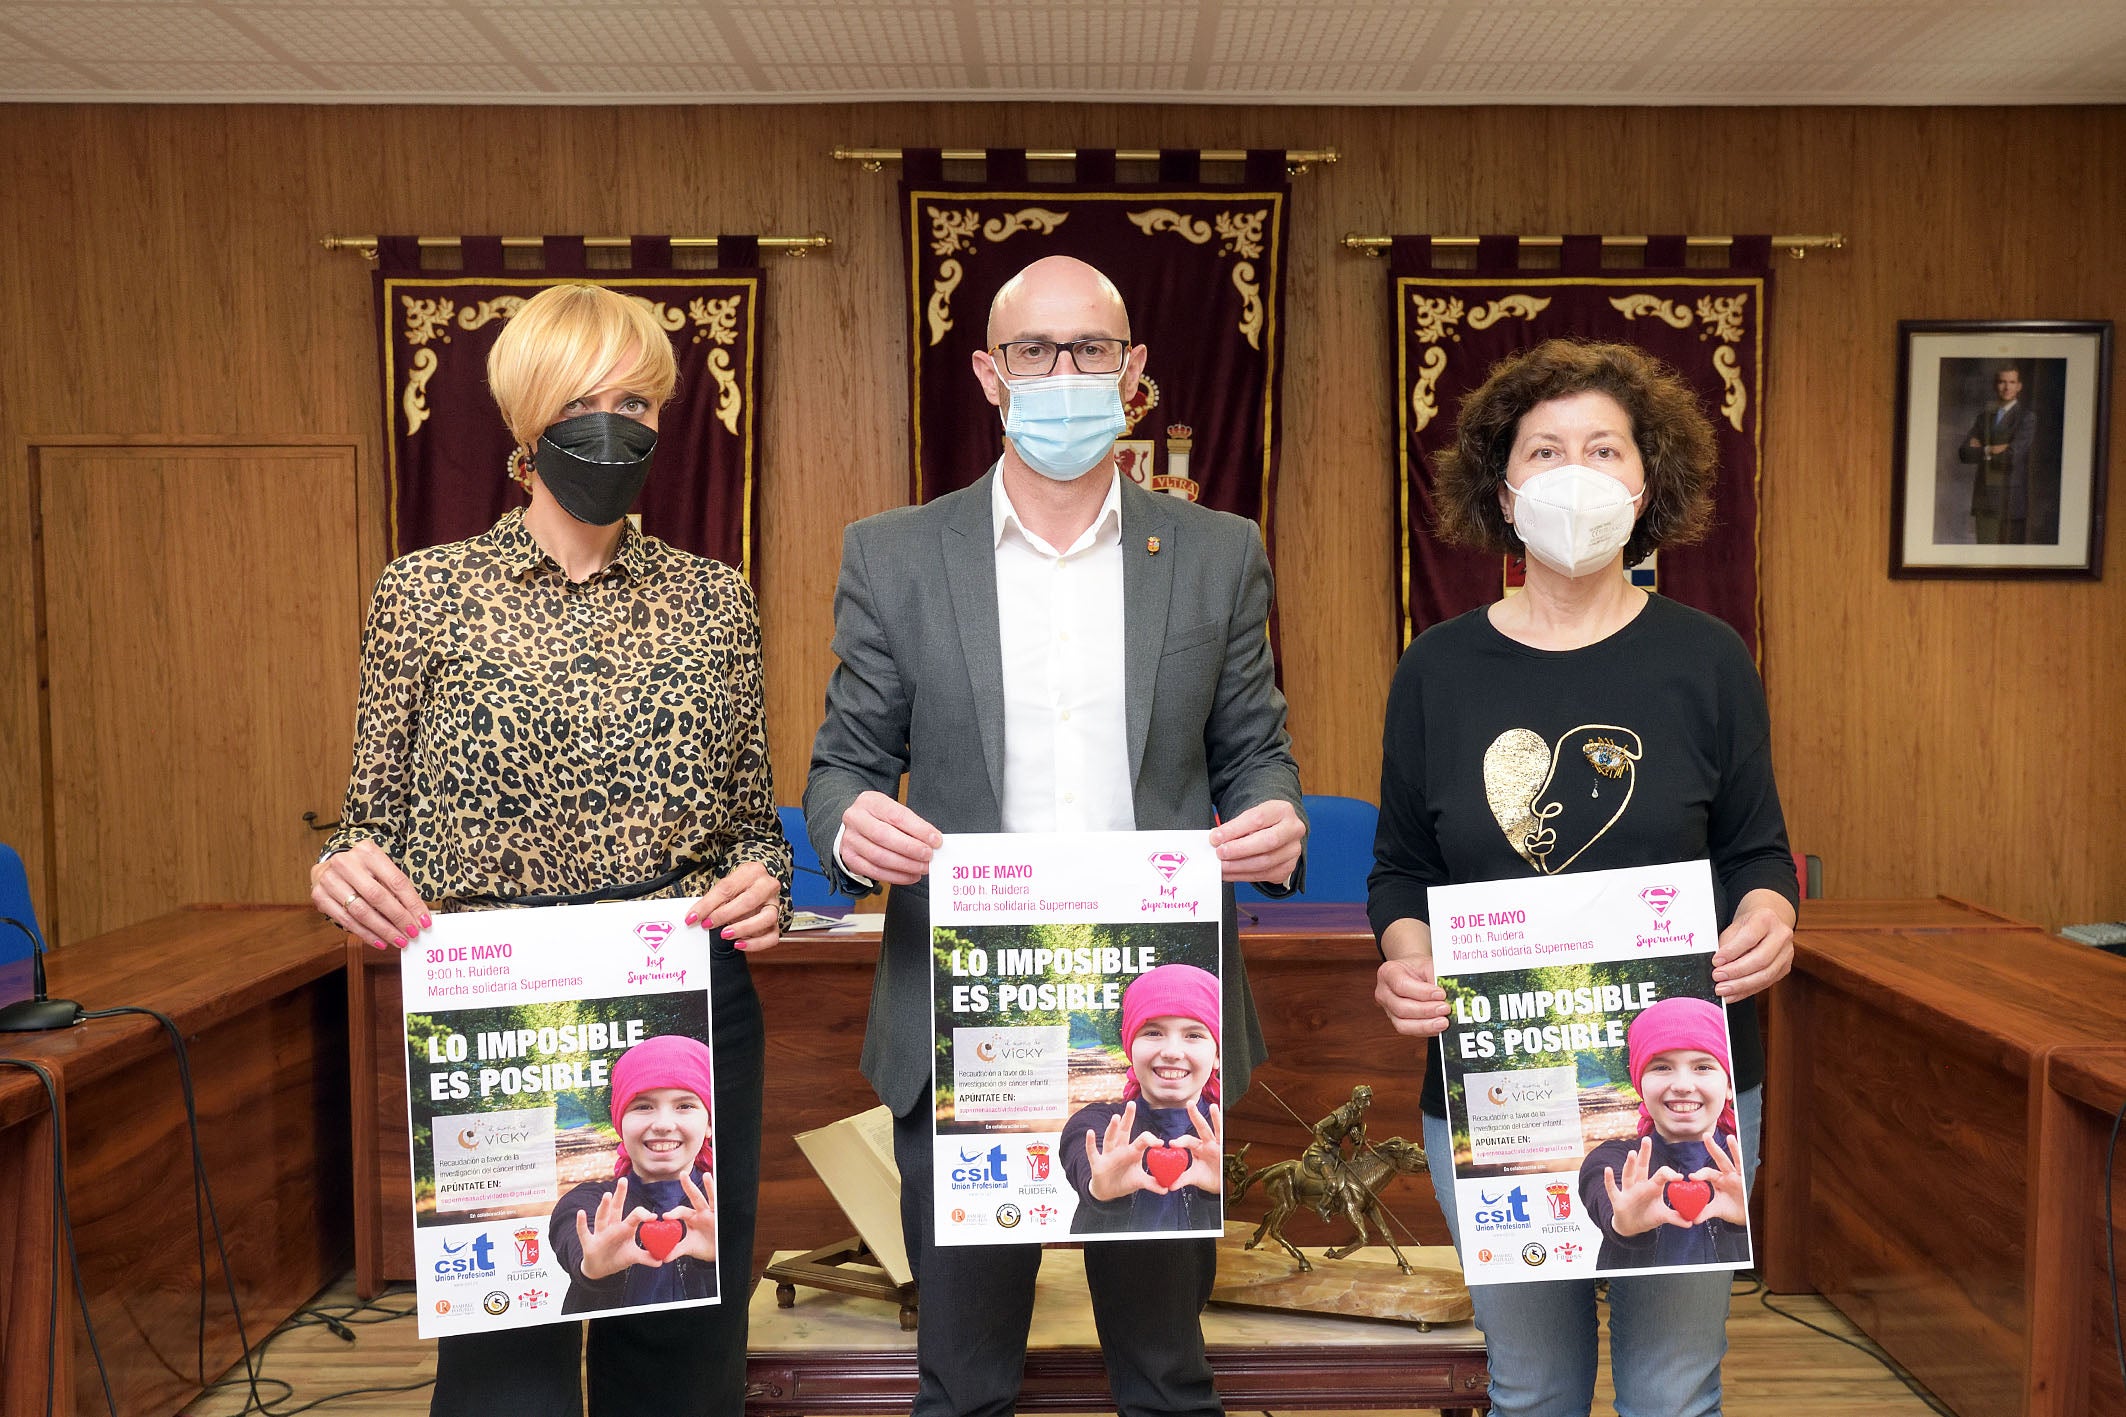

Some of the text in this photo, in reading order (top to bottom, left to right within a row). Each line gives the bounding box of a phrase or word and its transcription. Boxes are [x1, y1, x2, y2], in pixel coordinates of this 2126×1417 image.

[1158, 476, 1196, 495] VLTRA
[953, 864, 1033, 880] 30 DE MAYO
[953, 884, 1030, 896] 9:00 h. Ruidera
[953, 900, 1099, 913] Marcha solidaria Supernenas
[1451, 910, 1526, 929] 30 DE MAYO
[1452, 930, 1524, 945] 9:00 h. Ruidera
[427, 944, 512, 964] 30 DE MAYO
[1453, 940, 1594, 961] Marcha solidaria Supernenas
[952, 946, 1156, 977] LO IMPOSIBLE
[428, 966, 510, 980] 9:00 h. Ruidera
[428, 976, 583, 997] Marcha solidaria Supernenas
[953, 983, 1120, 1013] ES POSIBLE
[1456, 982, 1658, 1025] LO IMPOSIBLE
[428, 1019, 645, 1064] LO IMPOSIBLE
[1459, 1020, 1625, 1059] ES POSIBLE
[430, 1059, 609, 1101] ES POSIBLE
[959, 1093, 1016, 1102] APÚNTATE EN:
[1518, 1136, 1531, 1144] EN:
[440, 1180, 502, 1193] APÚNTATE EN:
[1019, 1187, 1058, 1195] RUIDERA
[1496, 1222, 1531, 1230] Profesional
[1542, 1225, 1581, 1234] RUIDERA
[458, 1270, 496, 1281] Profesional
[507, 1270, 548, 1281] RUIDERA
